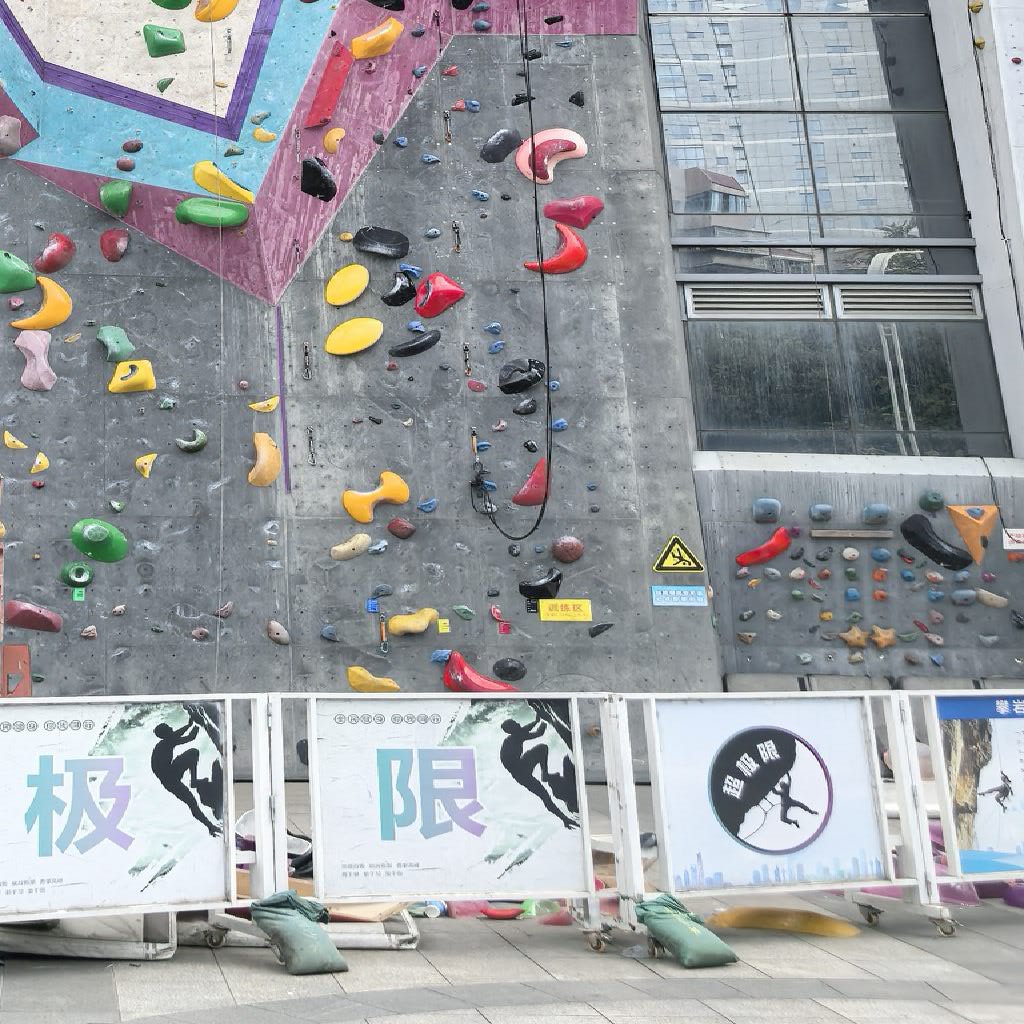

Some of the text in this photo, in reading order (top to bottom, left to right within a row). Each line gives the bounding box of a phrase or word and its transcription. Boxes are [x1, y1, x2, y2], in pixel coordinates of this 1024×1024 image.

[24, 754, 136, 858] 极
[376, 748, 488, 842] 限
[722, 739, 781, 800] 超极限
